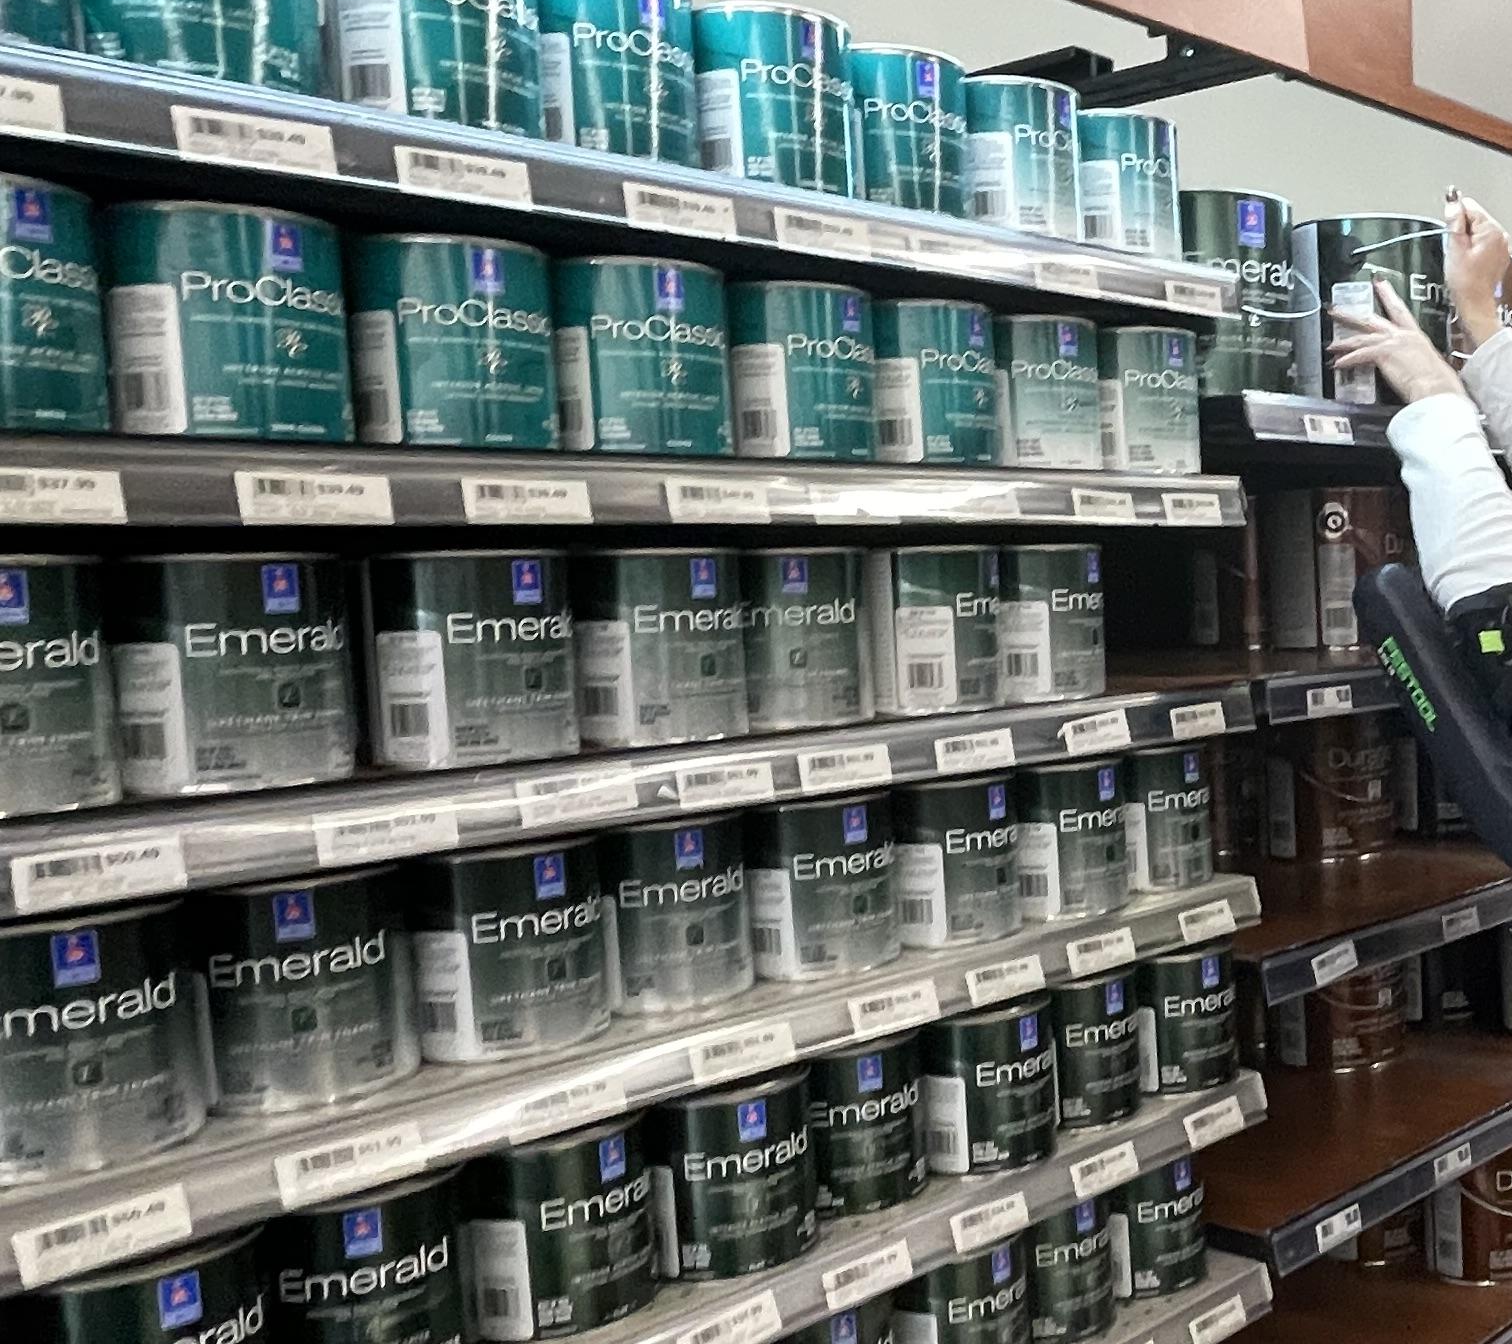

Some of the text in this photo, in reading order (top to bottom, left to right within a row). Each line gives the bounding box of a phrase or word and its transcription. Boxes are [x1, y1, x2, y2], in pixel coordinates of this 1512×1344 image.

[208, 928, 386, 988] Emerald
[809, 1081, 920, 1128] Emerald
[684, 1124, 808, 1182] Emerald
[278, 1236, 448, 1304] Emerald
